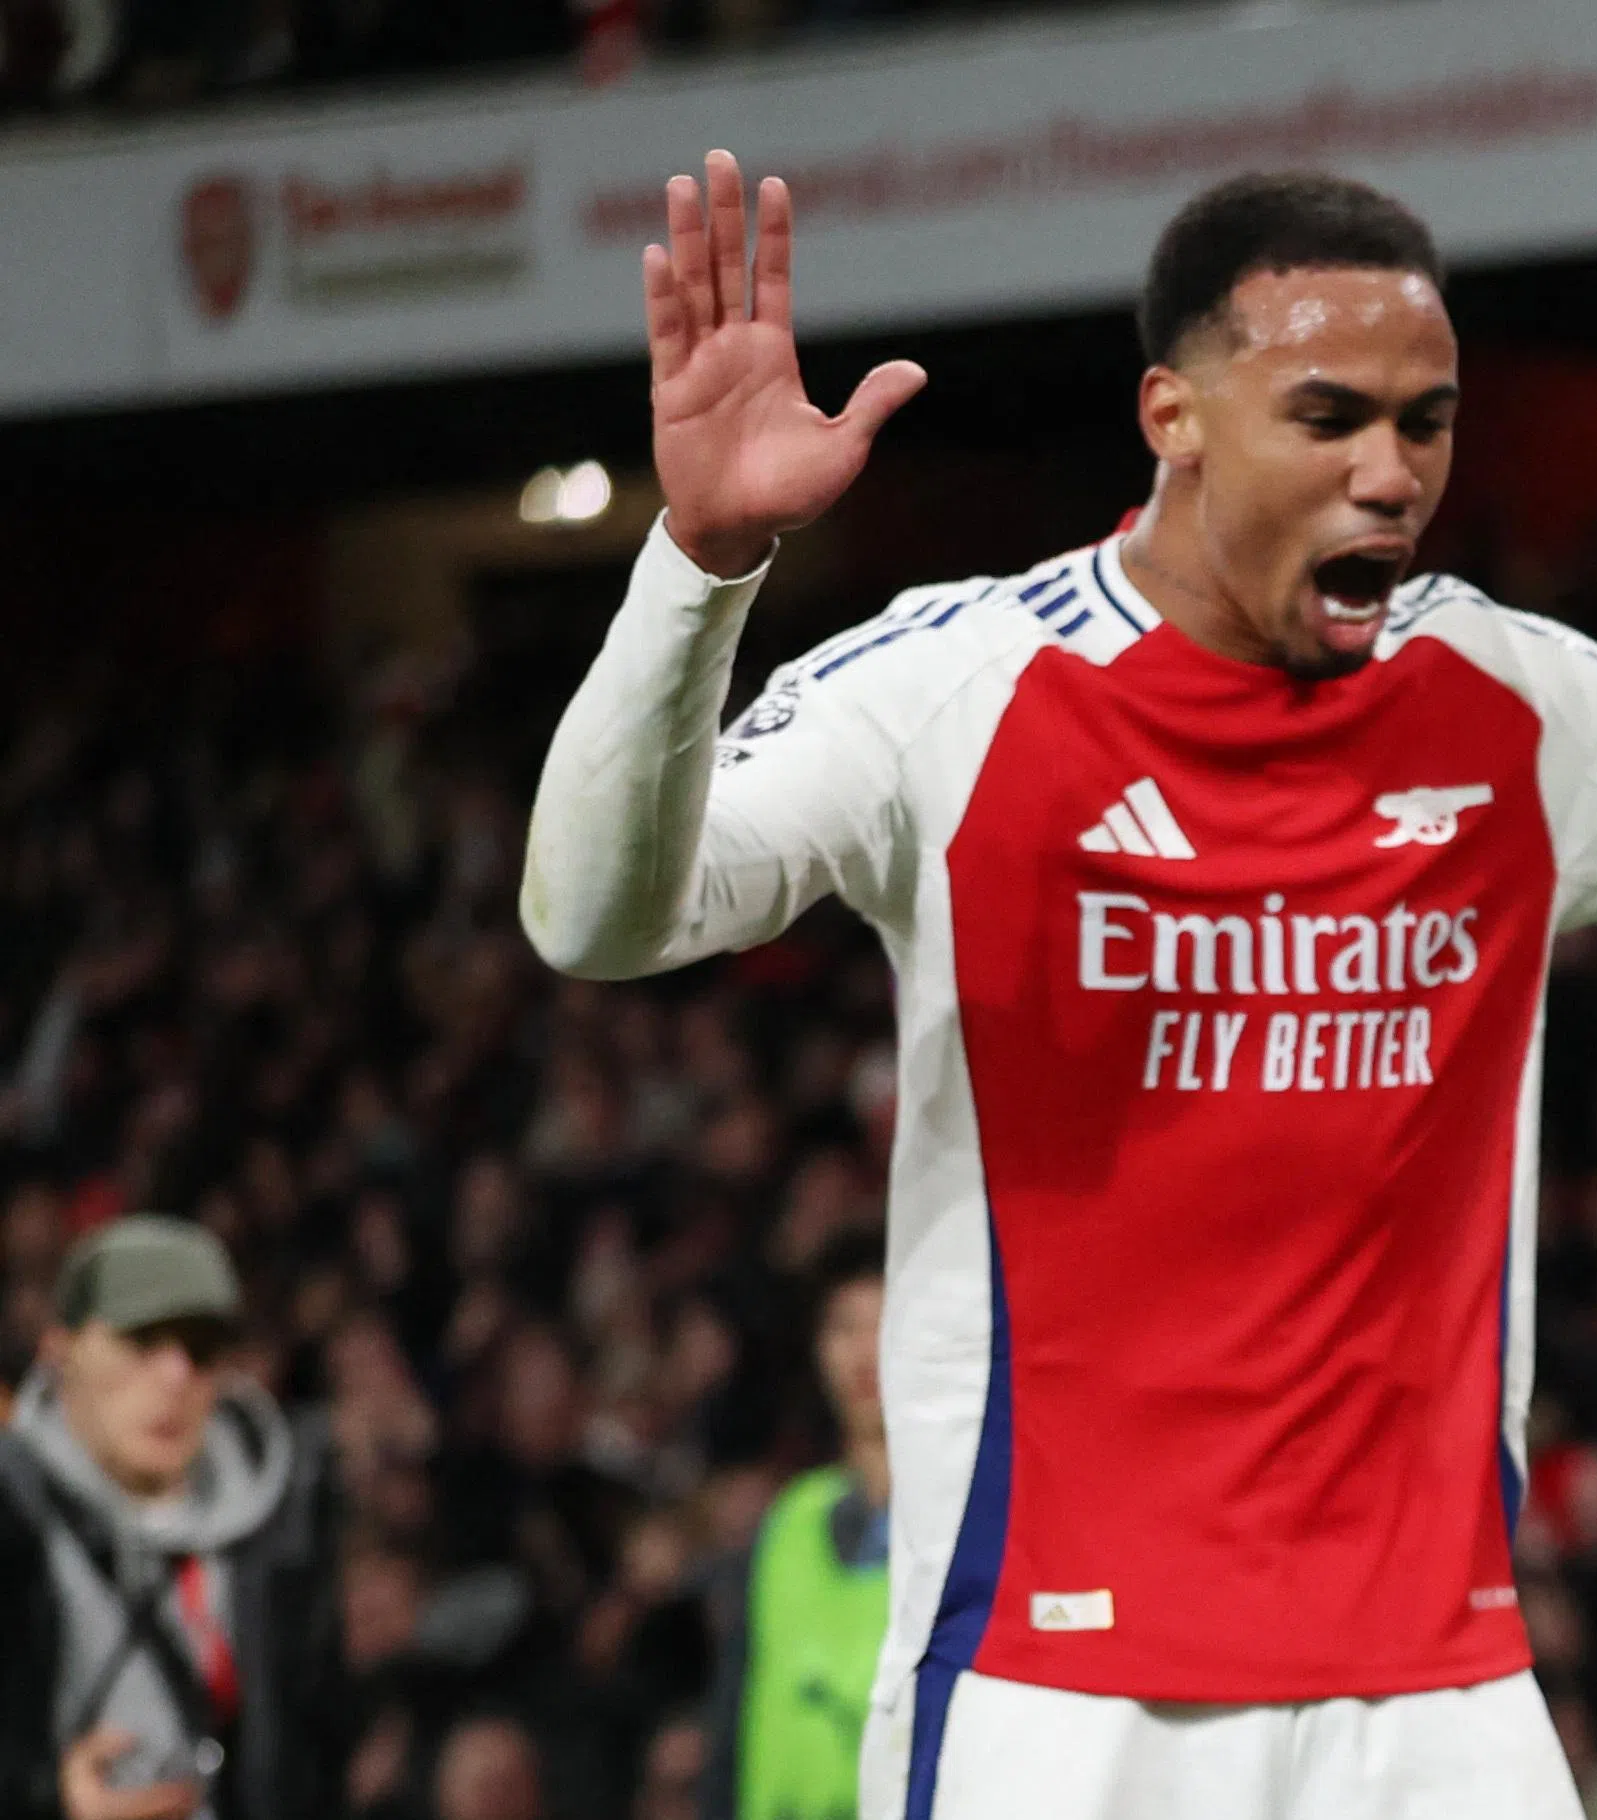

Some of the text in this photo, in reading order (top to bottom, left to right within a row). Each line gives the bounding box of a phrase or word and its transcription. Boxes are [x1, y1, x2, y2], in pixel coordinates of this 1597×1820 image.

[1075, 890, 1479, 995] Emirates
[1142, 1006, 1434, 1093] FLY BETTER
